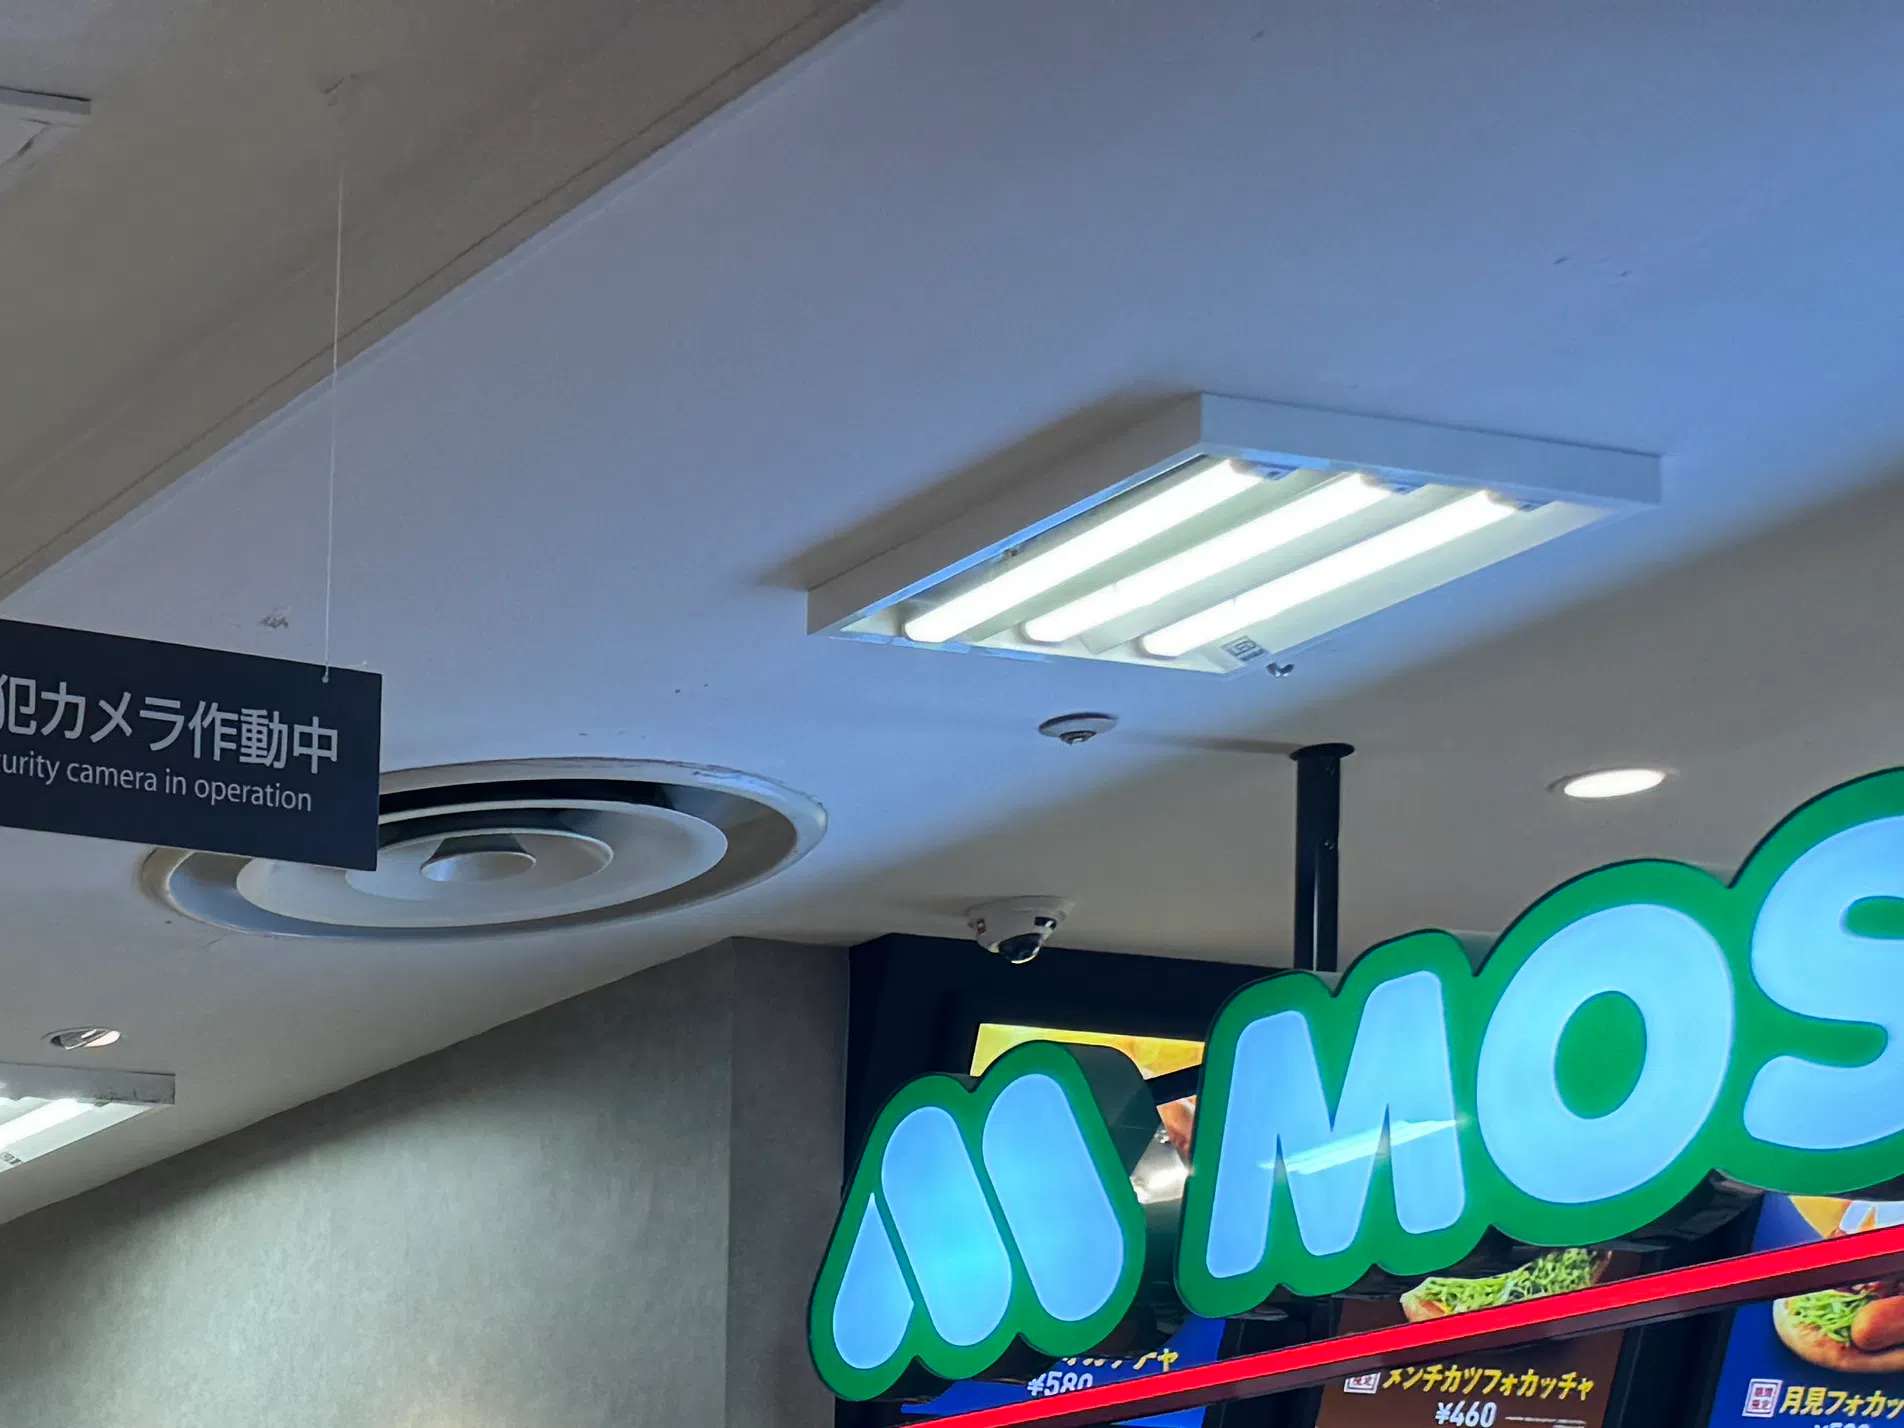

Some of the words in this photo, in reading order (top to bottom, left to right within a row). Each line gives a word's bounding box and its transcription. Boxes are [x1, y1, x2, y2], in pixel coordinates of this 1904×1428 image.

[66, 759, 158, 793] camera
[165, 768, 187, 796] in
[194, 775, 312, 813] operation
[1206, 812, 1904, 1279] MOS
[1382, 1363, 1594, 1402] メンチカツフォカッチャ
[1435, 1400, 1498, 1428] ¥460
